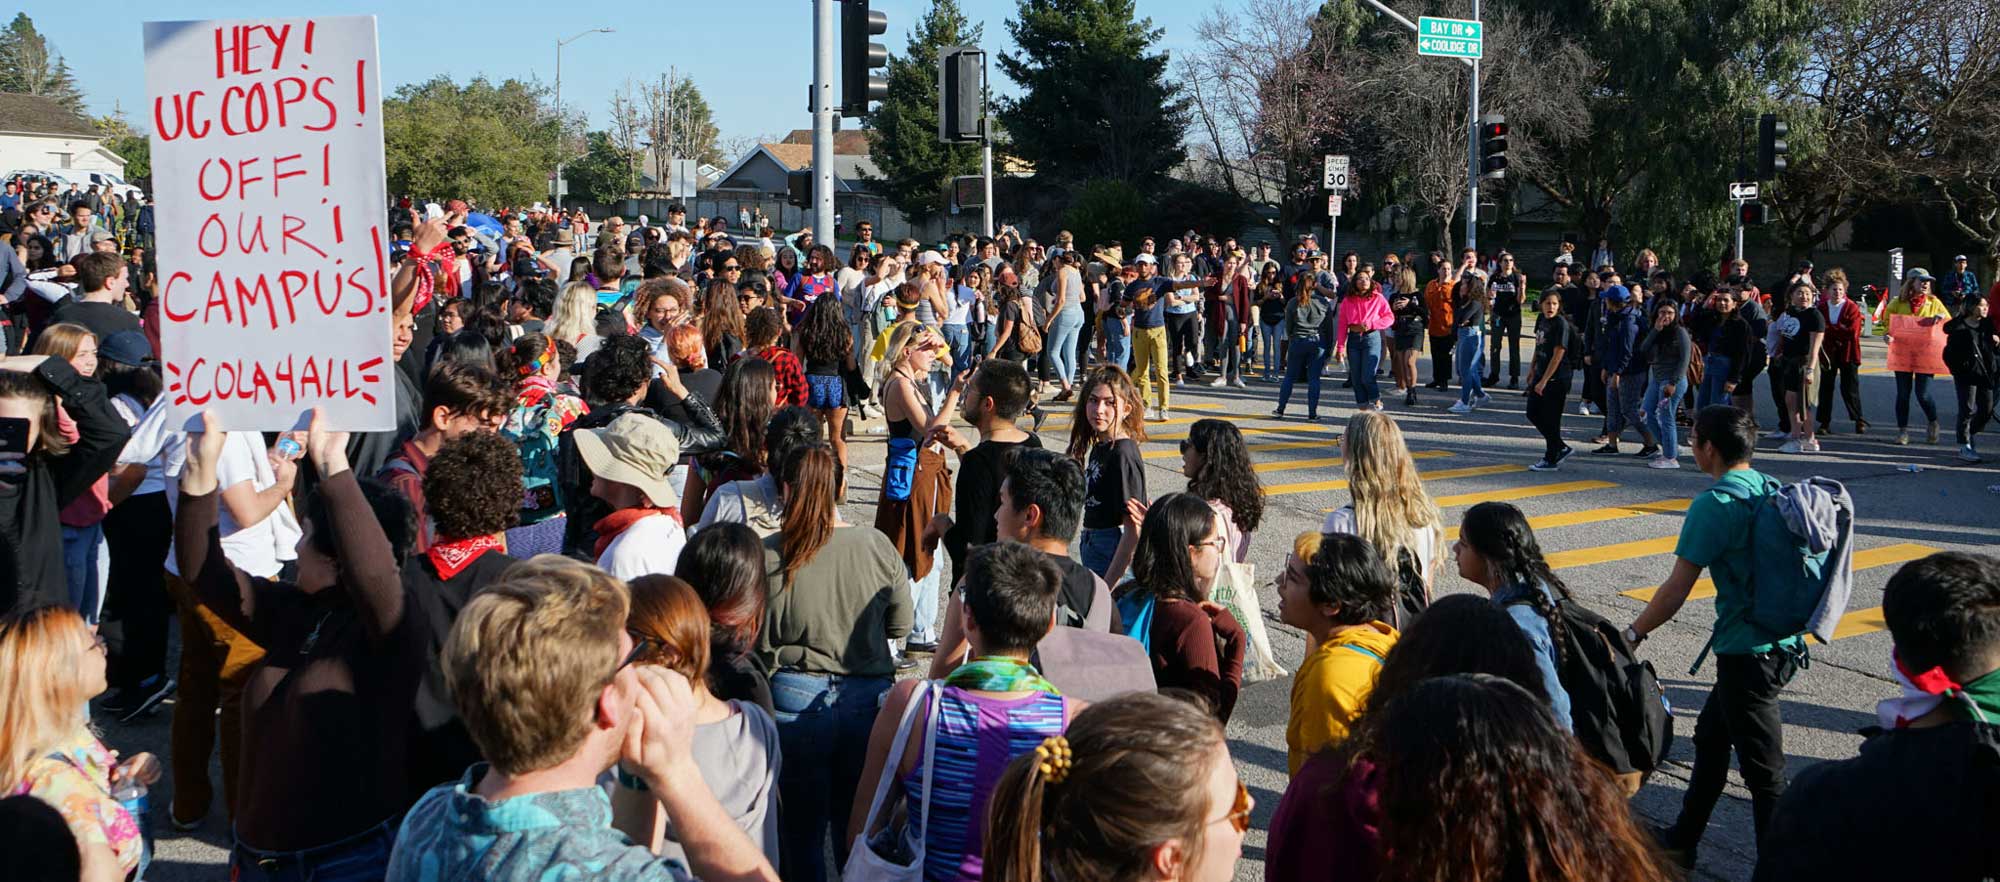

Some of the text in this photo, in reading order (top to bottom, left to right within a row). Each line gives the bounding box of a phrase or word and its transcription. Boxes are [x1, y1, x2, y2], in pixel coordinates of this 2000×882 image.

[214, 20, 317, 79] HEY!
[1431, 22, 1463, 35] BAY DR
[1431, 40, 1478, 53] COOLIDGE DR
[154, 90, 212, 140] UC
[197, 143, 330, 204] OFF!
[1327, 173, 1346, 186] 30
[163, 225, 388, 331] CAMPUS!
